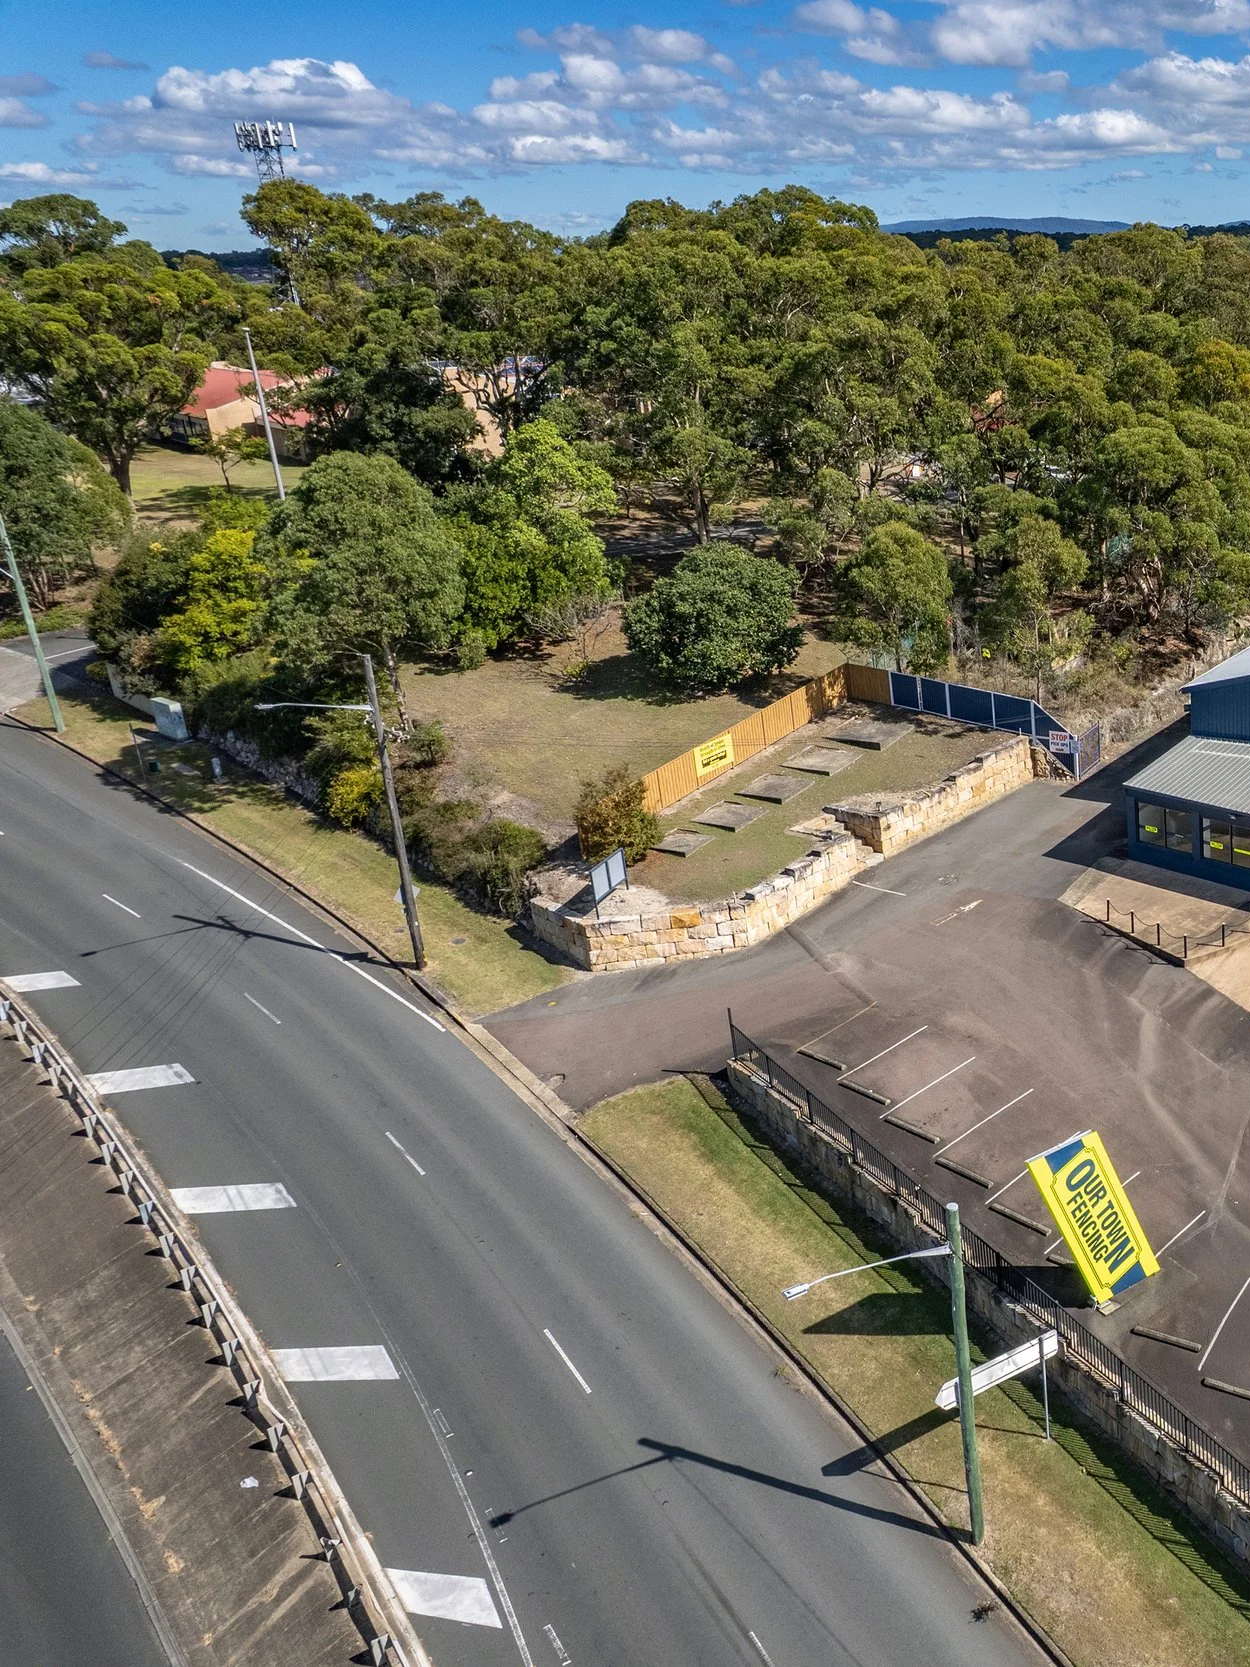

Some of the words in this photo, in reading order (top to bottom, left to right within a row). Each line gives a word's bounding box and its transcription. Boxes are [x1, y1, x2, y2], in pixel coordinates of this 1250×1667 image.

[1051, 733, 1068, 741] STOP
[1065, 1158, 1108, 1209] OUR
[1096, 1199, 1136, 1274] TOWN
[1066, 1190, 1109, 1263] FENCING
